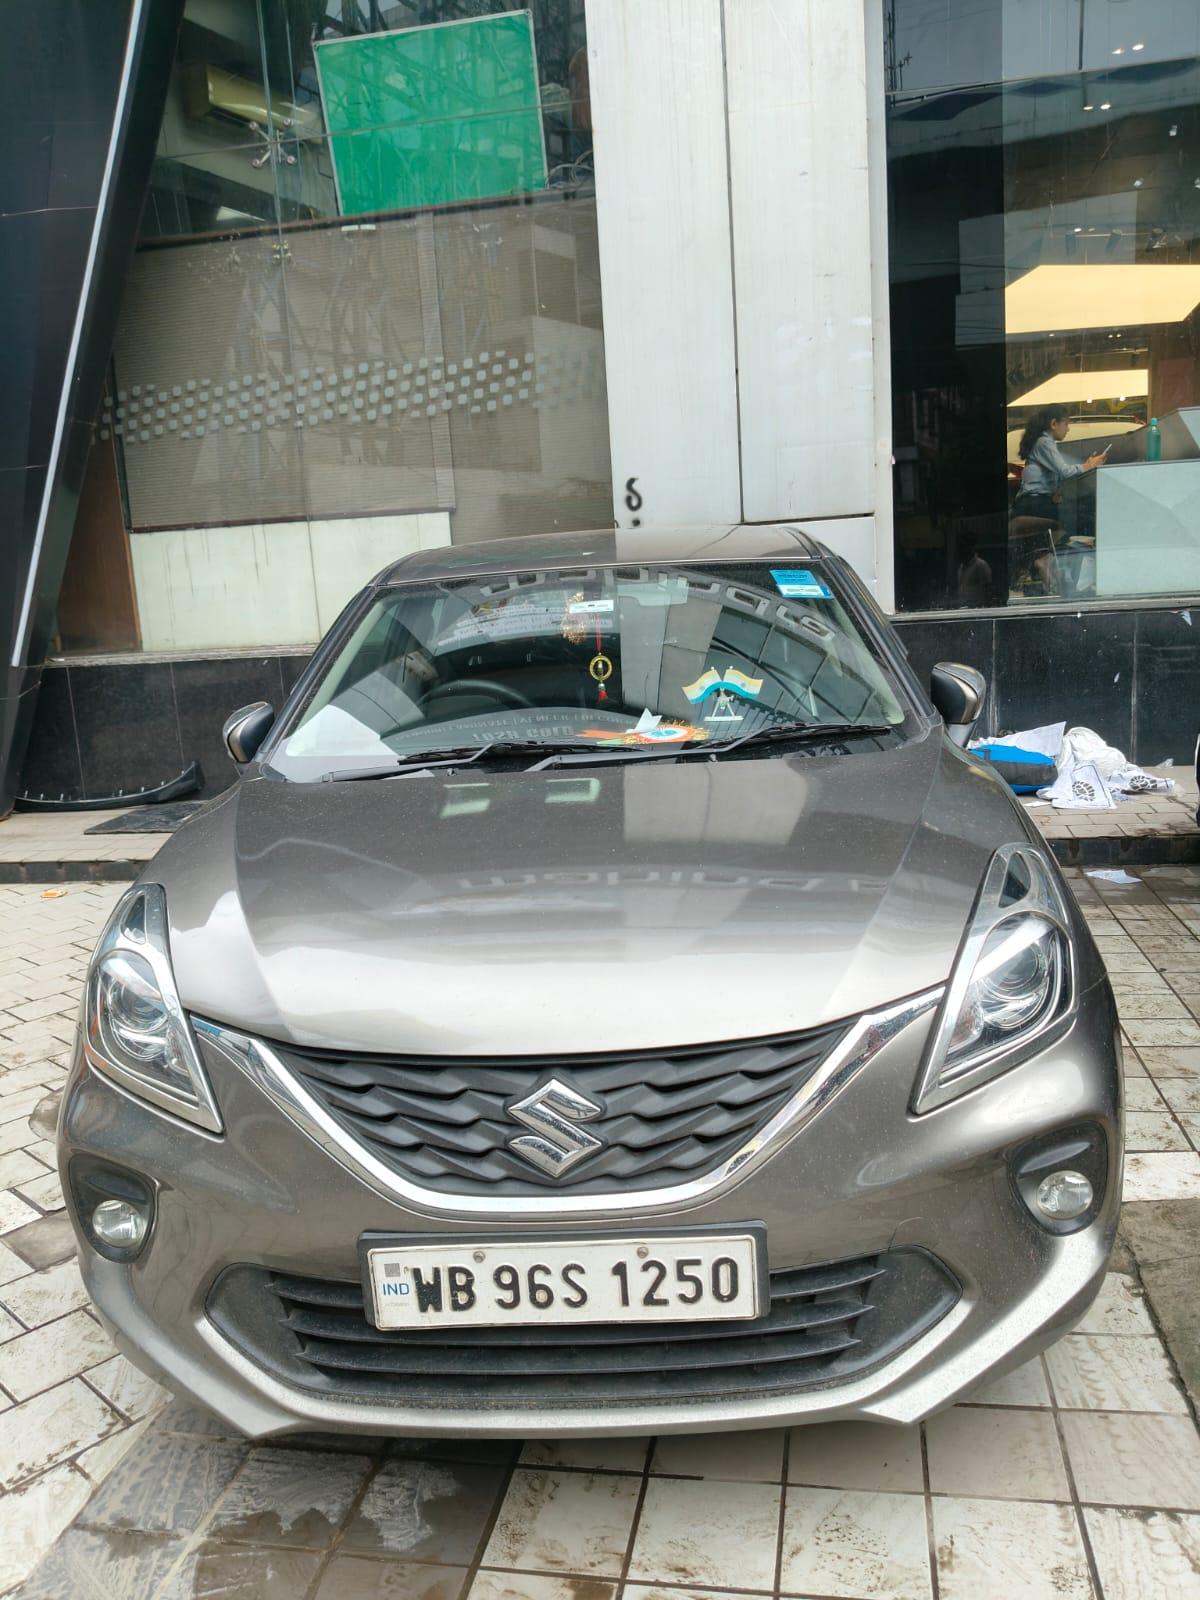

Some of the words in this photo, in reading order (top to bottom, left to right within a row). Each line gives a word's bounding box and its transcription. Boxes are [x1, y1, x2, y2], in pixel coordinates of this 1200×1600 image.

[382, 1283, 410, 1296] IND
[412, 1264, 476, 1313] WB
[492, 1262, 588, 1310] 96S
[612, 1256, 739, 1307] 1250
